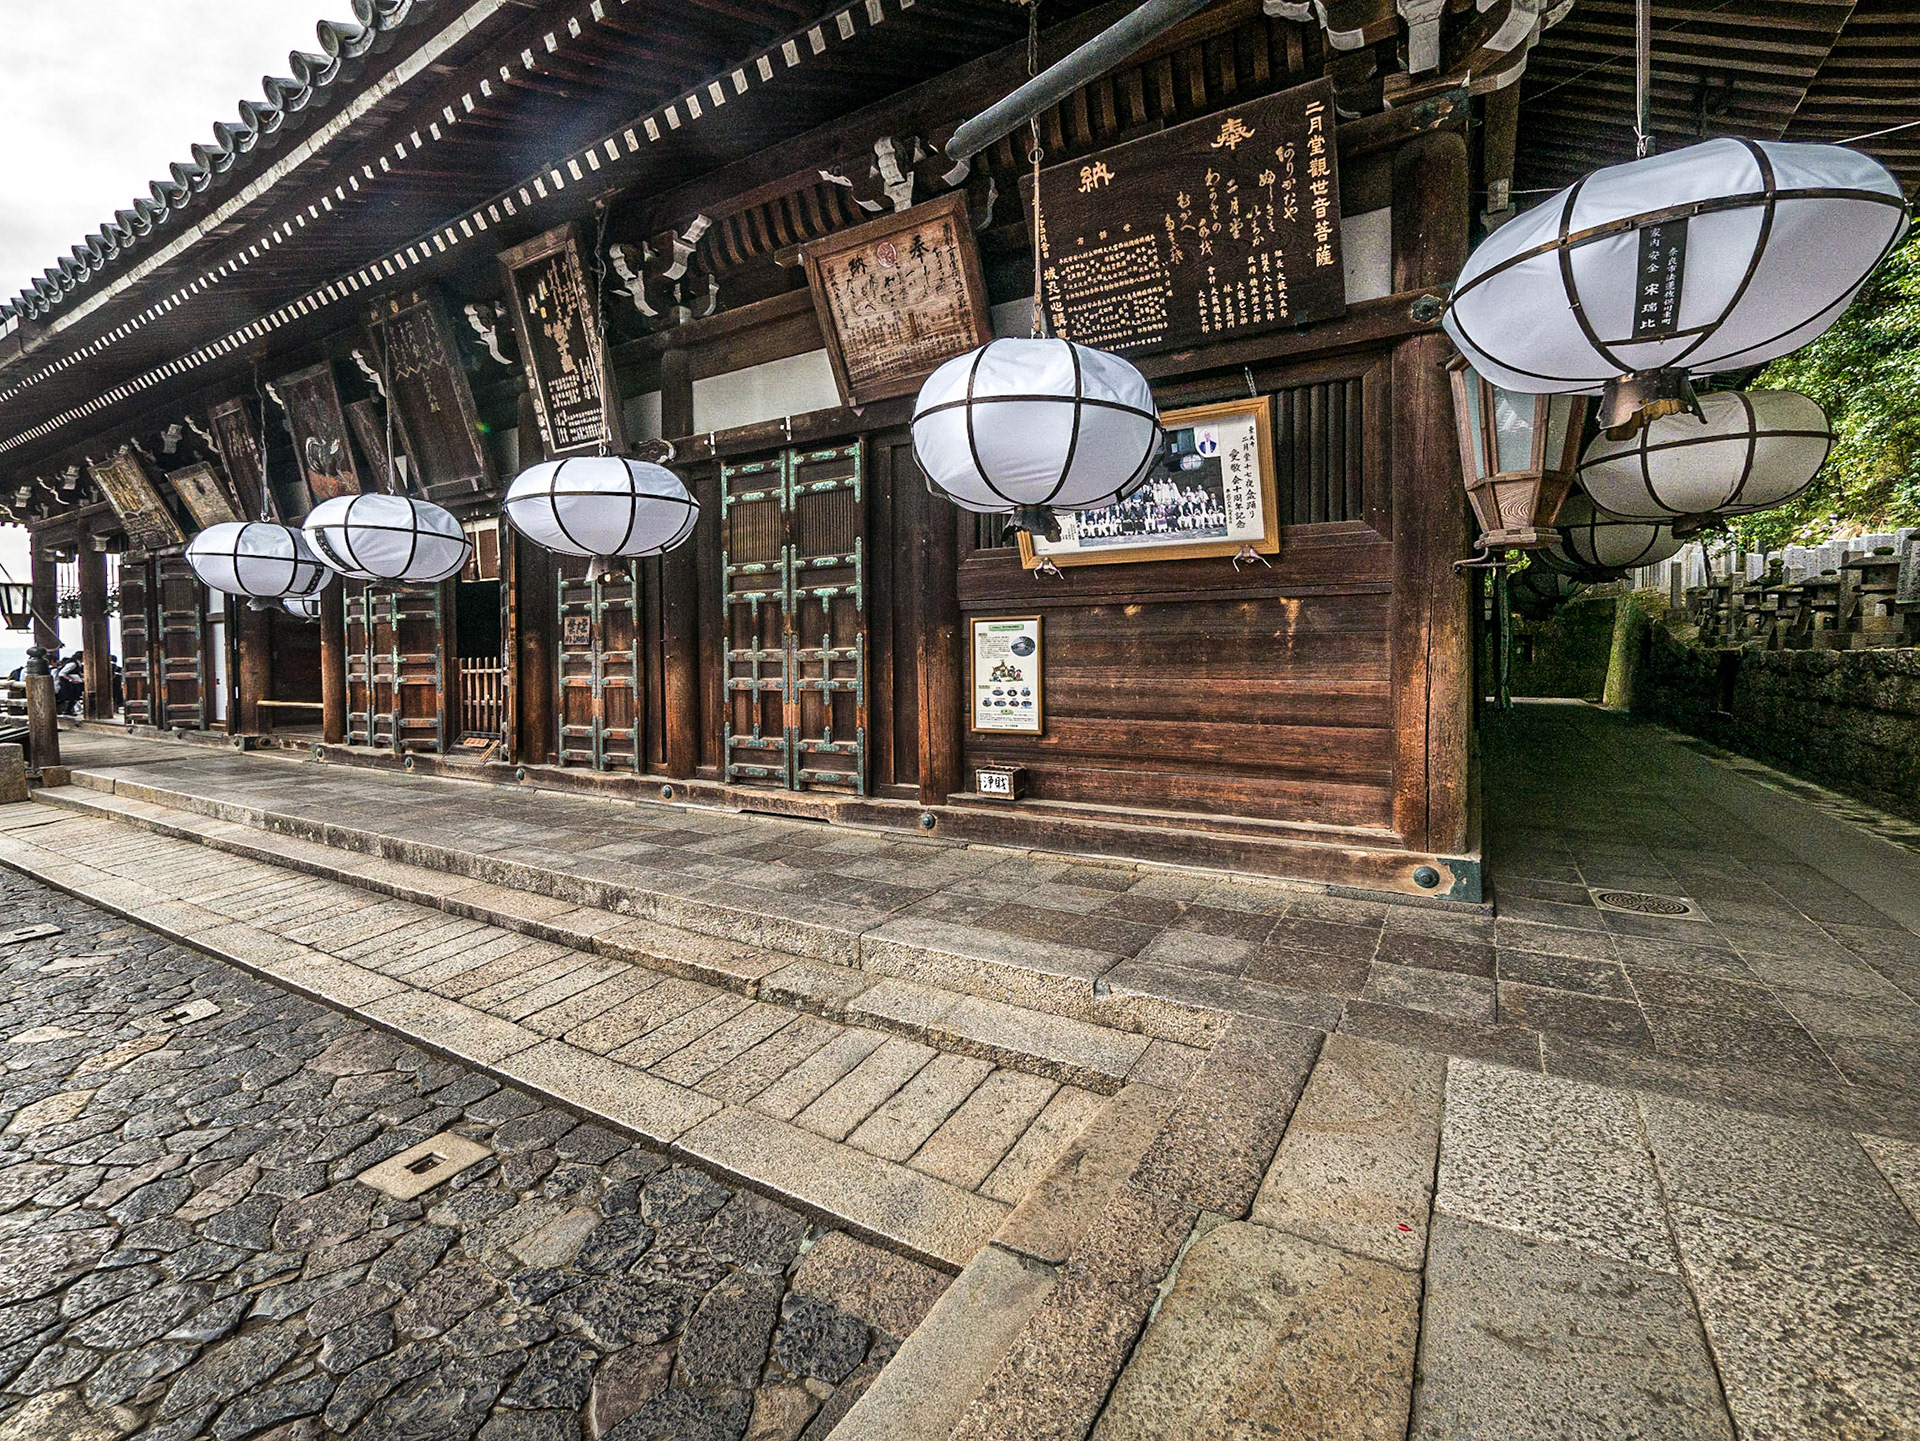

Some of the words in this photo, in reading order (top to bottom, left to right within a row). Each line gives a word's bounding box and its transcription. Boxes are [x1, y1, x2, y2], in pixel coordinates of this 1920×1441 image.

[1305, 101, 1335, 267] 二月堂觀世音菩薩
[1645, 227, 1661, 274] 家内安全
[1639, 283, 1660, 330] 宋瑞比
[1241, 436, 1257, 519] 二月堂十七夜盆踊り
